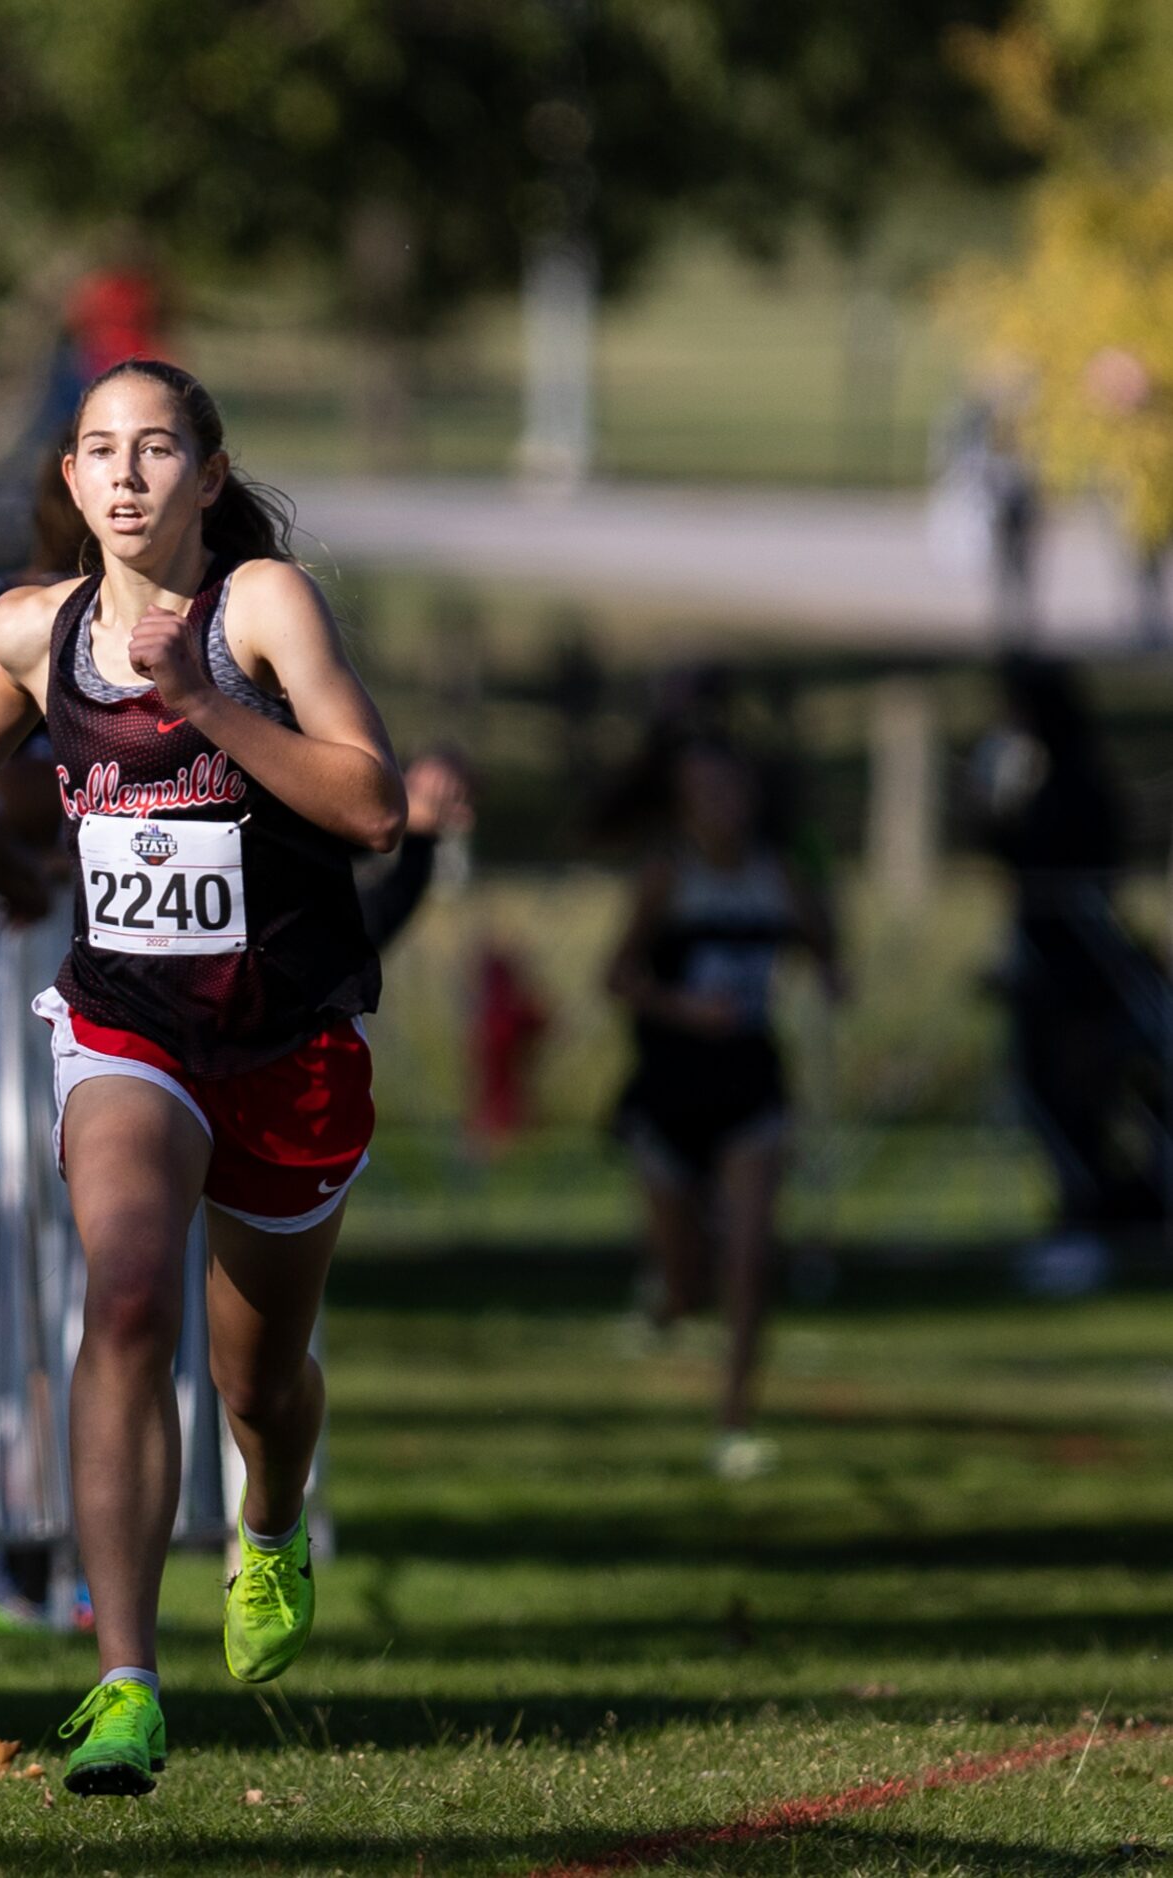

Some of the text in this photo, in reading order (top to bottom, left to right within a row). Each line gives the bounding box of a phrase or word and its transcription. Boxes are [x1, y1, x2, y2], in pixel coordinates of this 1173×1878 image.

[56, 750, 246, 819] Colleyville
[130, 839, 178, 855] STATE
[90, 870, 232, 931] 2240
[146, 937, 170, 947] 2022
